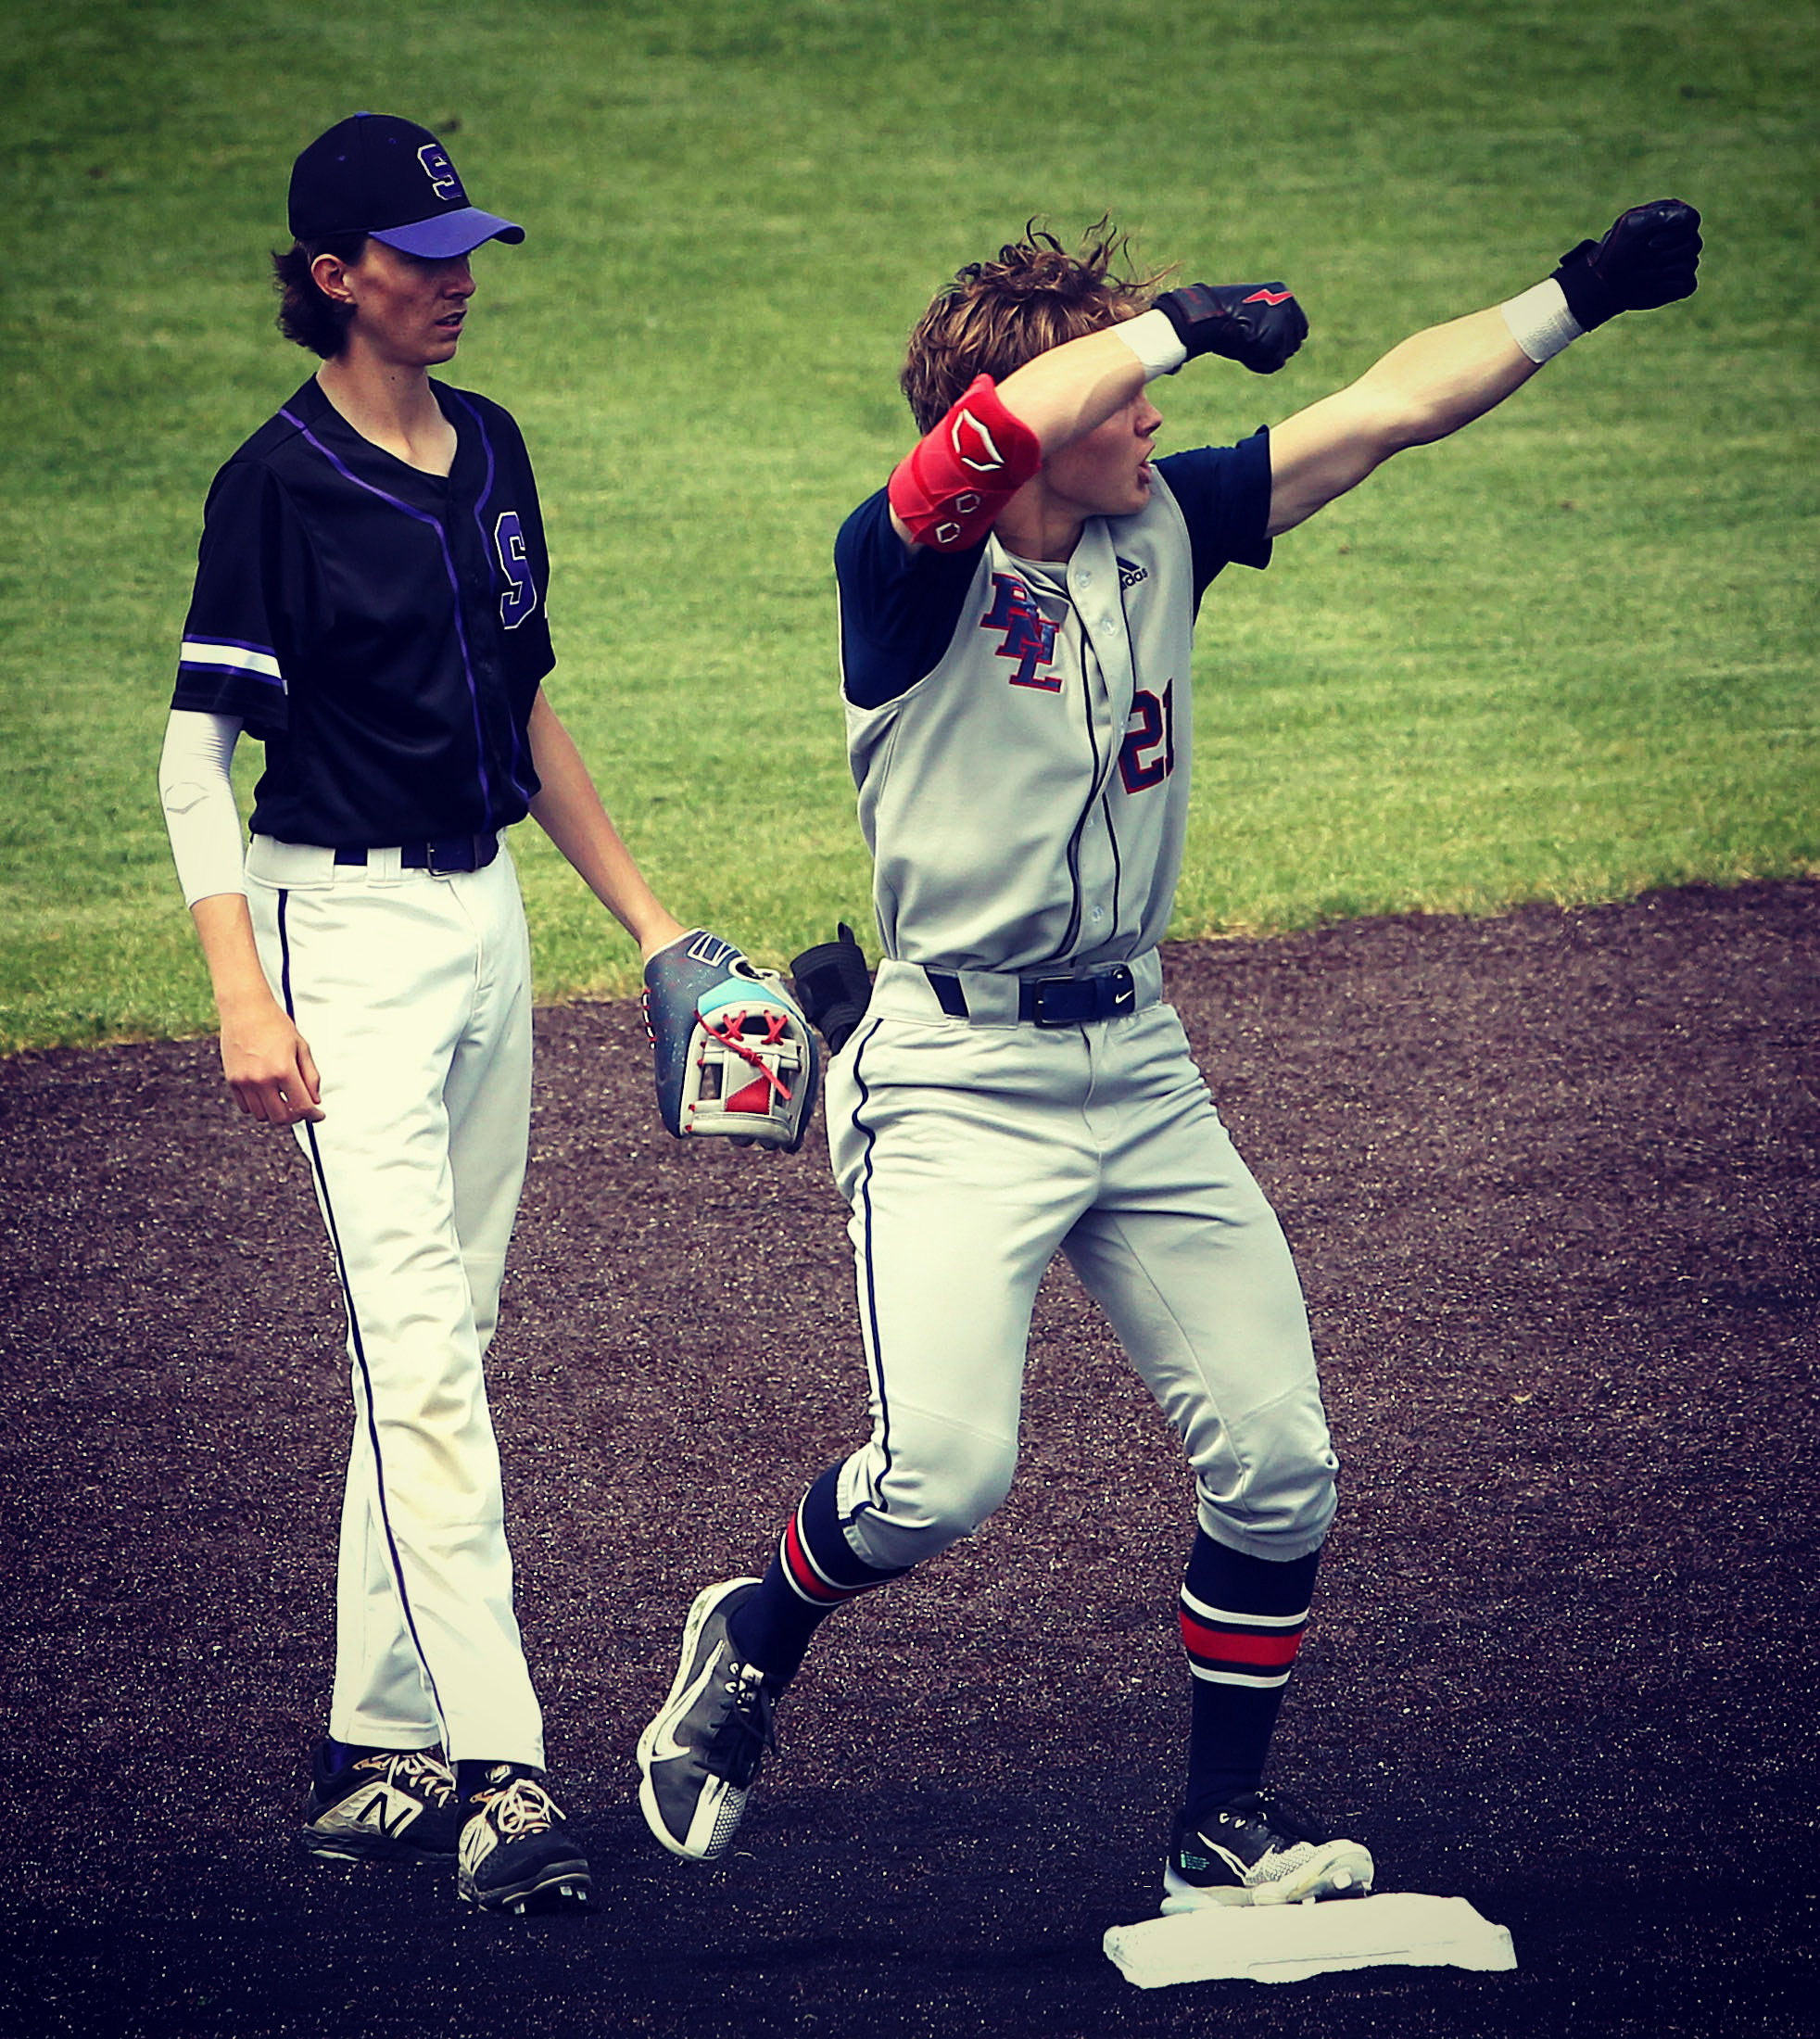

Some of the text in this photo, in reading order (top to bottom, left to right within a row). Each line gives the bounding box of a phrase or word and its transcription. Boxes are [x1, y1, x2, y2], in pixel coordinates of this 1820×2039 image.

[417, 143, 462, 201] S
[494, 511, 537, 629] S
[1118, 678, 1174, 794] 21
[356, 1791, 413, 1837] N
